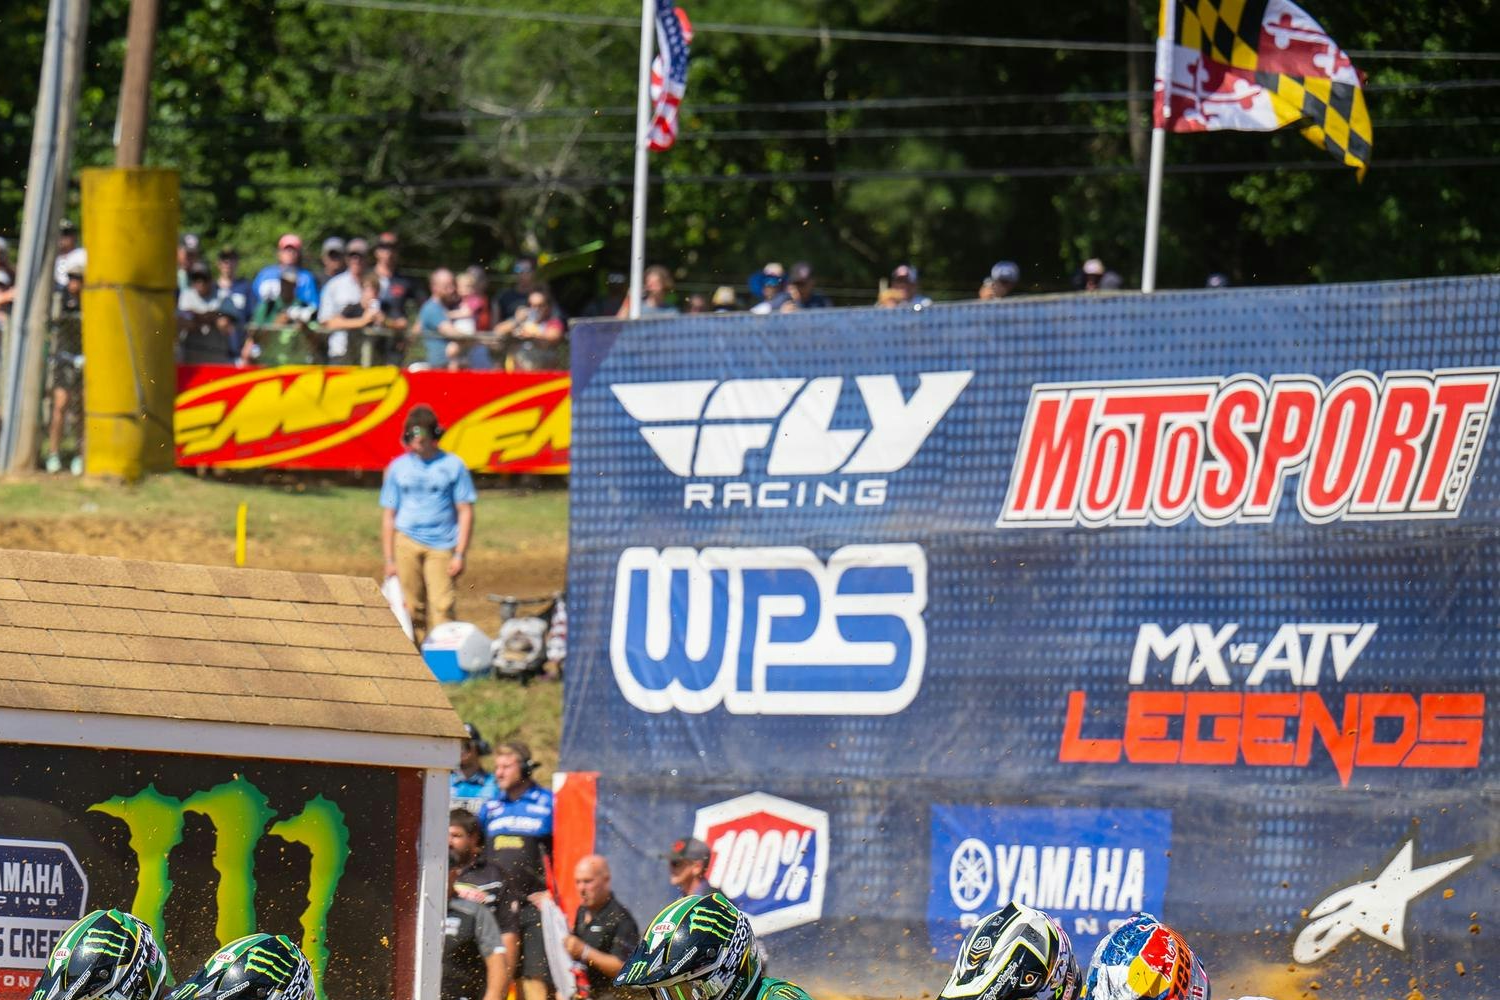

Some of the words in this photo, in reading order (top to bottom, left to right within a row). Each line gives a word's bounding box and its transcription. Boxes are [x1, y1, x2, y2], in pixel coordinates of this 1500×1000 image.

[609, 369, 976, 477] FLY
[1003, 373, 1493, 520] MOTOSPORT
[684, 480, 887, 510] RACING
[611, 543, 928, 716] WPS
[1128, 623, 1238, 685] MX
[1247, 623, 1377, 685] ATV
[1058, 691, 1485, 788] LEGENDS
[709, 828, 811, 900] 100%
[995, 844, 1145, 912] YAMAHA
[10, 928, 60, 958] CREE
[216, 953, 231, 961] BELL
[653, 923, 674, 932] BELL
